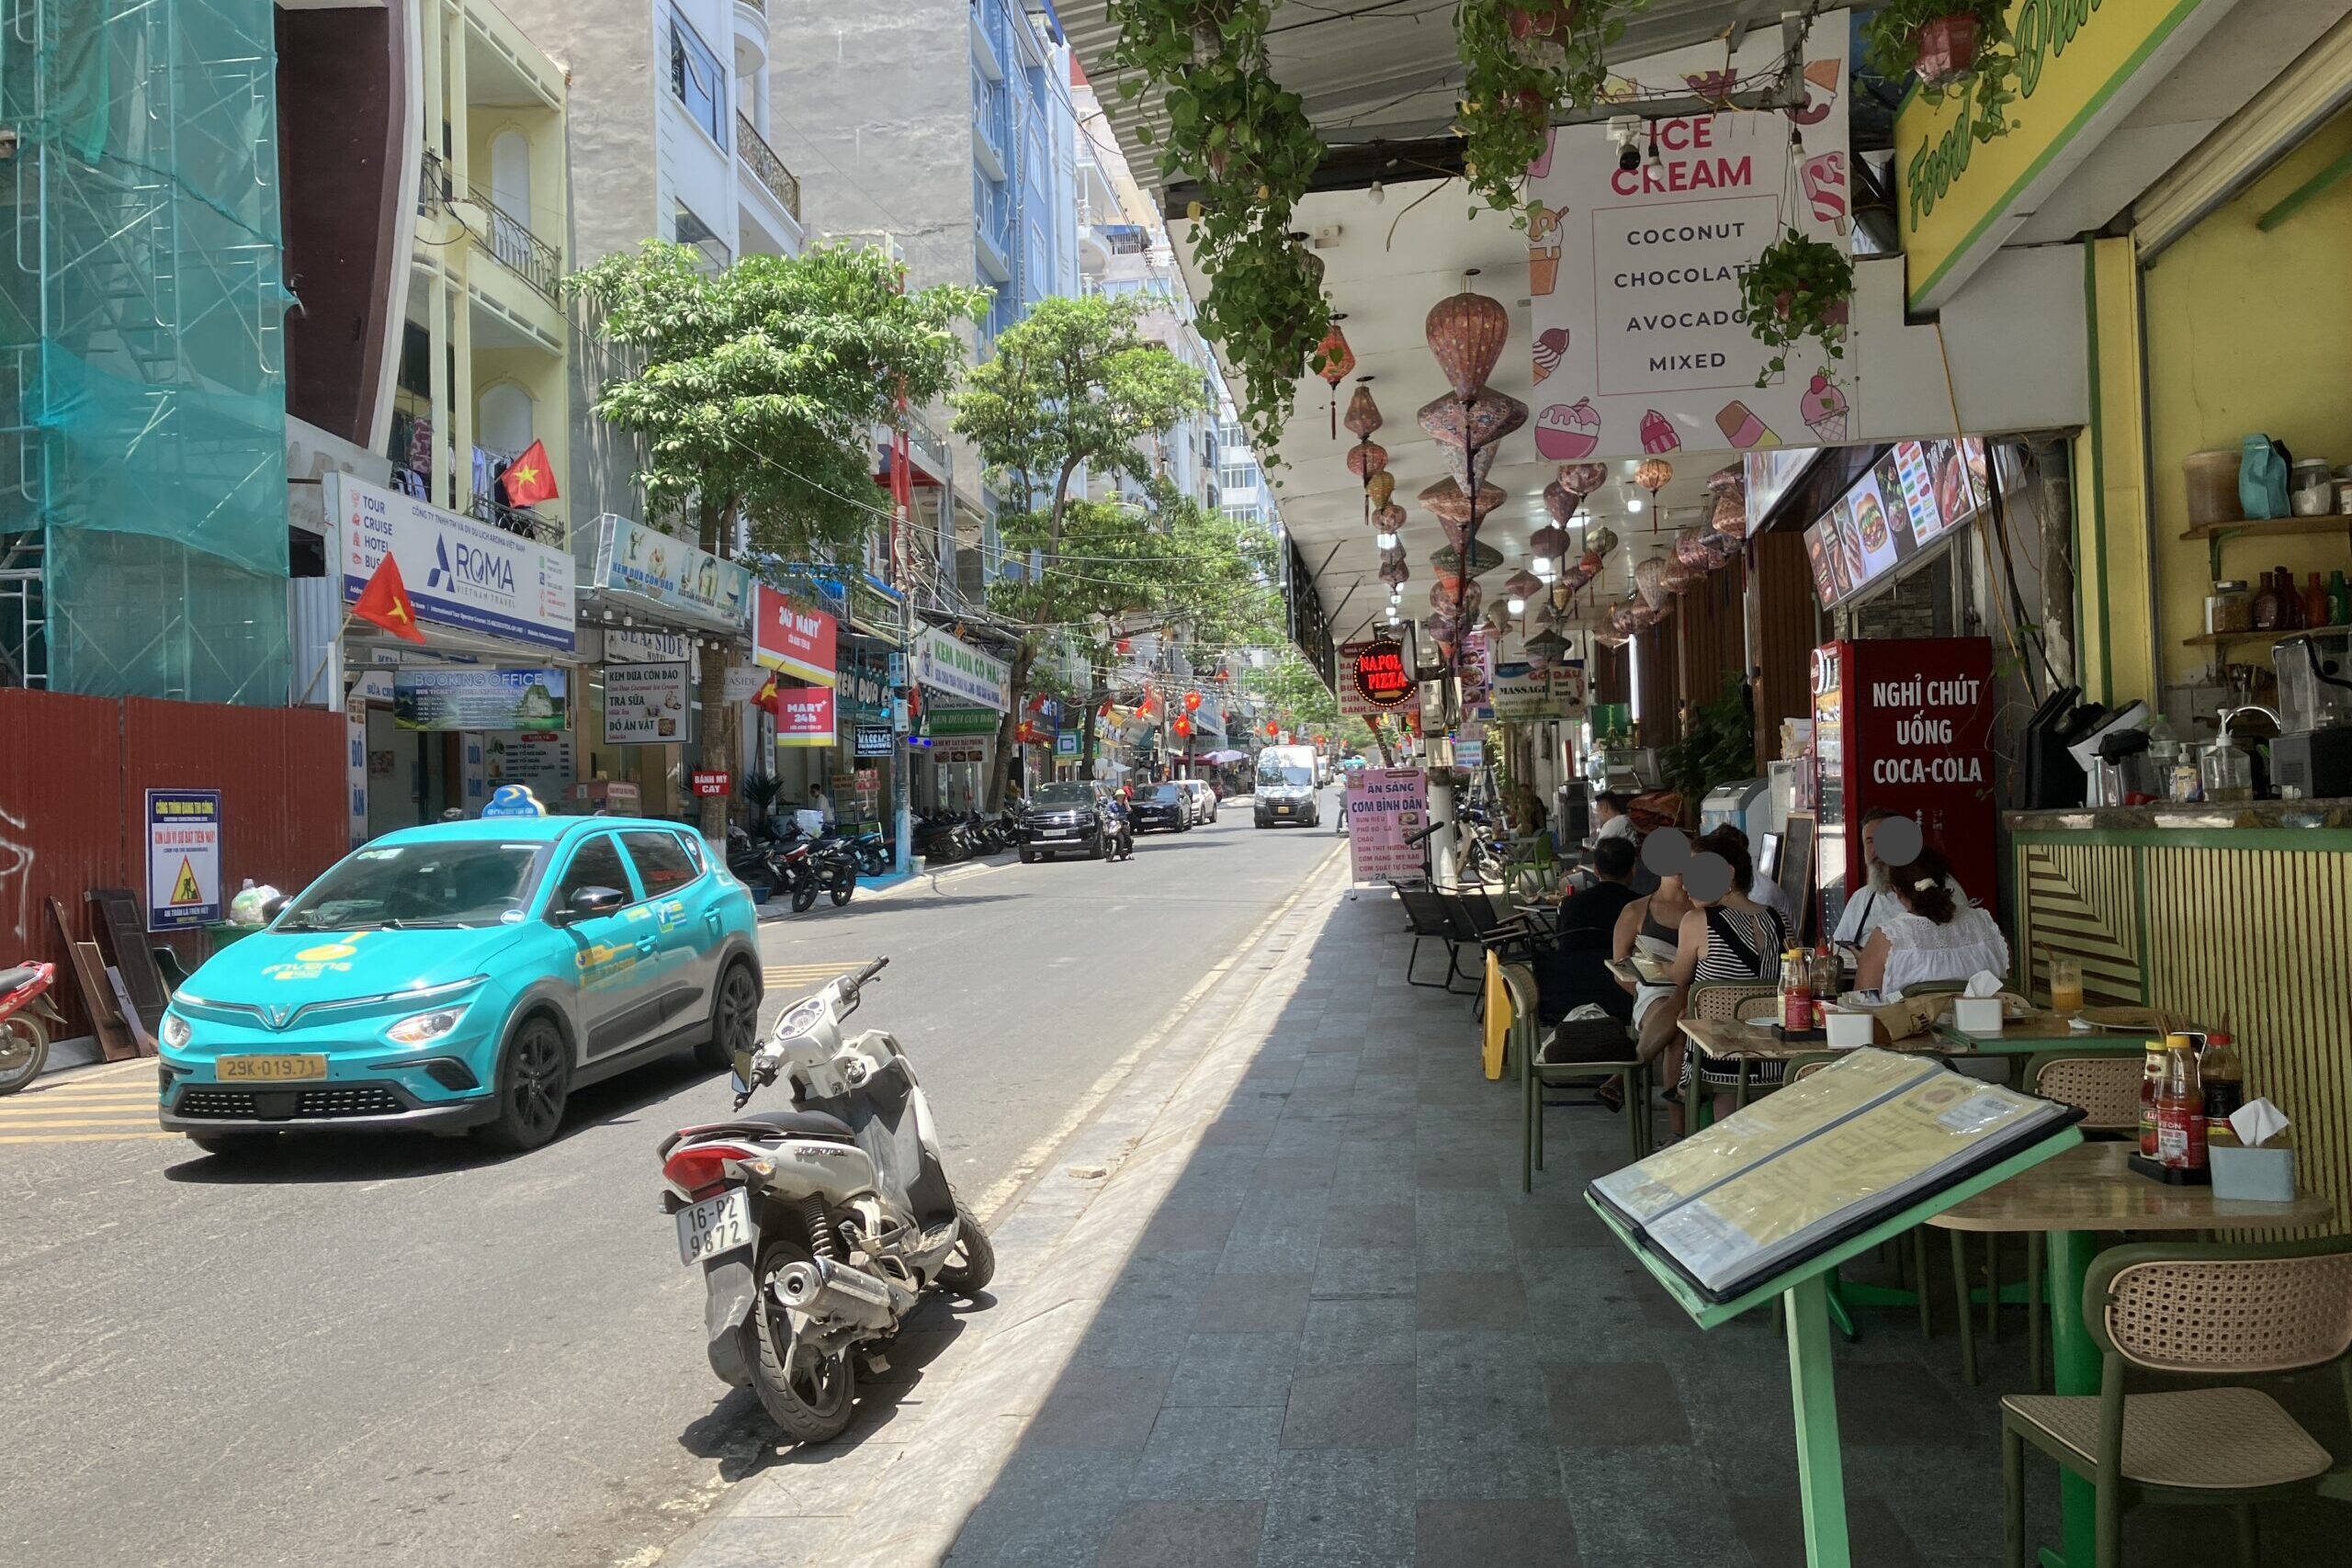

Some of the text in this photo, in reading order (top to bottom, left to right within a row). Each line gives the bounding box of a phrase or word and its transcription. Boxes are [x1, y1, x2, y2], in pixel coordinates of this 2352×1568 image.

[1649, 117, 1713, 151] ICE
[1908, 89, 1973, 232] Food
[1611, 155, 1752, 197] CREAM
[1626, 222, 1746, 246] COCONUT
[1626, 309, 1747, 333] AVOCADO
[1649, 353, 1726, 372] MIXED
[363, 495, 386, 514] TOUR
[364, 515, 393, 536] CRUISE
[613, 561, 628, 576] KEM
[457, 584, 515, 609] VIETNAM TRAVEL
[655, 632, 684, 658] SIDE
[934, 639, 954, 667] KEM
[1359, 653, 1403, 672] NAPOL
[413, 671, 544, 687] BOOKING OFFICE
[609, 671, 625, 682] KEM
[724, 676, 757, 686] EASIDE
[1367, 671, 1408, 690] PIZZA
[628, 693, 645, 706] SỮA
[1872, 673, 1980, 707] NGHỈ CHÚT
[1896, 709, 1953, 746] UỐNG
[694, 774, 715, 784] BÁNH
[1873, 757, 1983, 784] COCA-COLA
[701, 784, 721, 794] CAY
[1367, 780, 1415, 795] ĂN SÁNG
[1351, 795, 1423, 813] CƠM BÌNH DÂN
[154, 830, 164, 845] XIN
[1374, 873, 1387, 881] 2A
[687, 1195, 739, 1233] 16-P2
[689, 1219, 742, 1258] 9872
